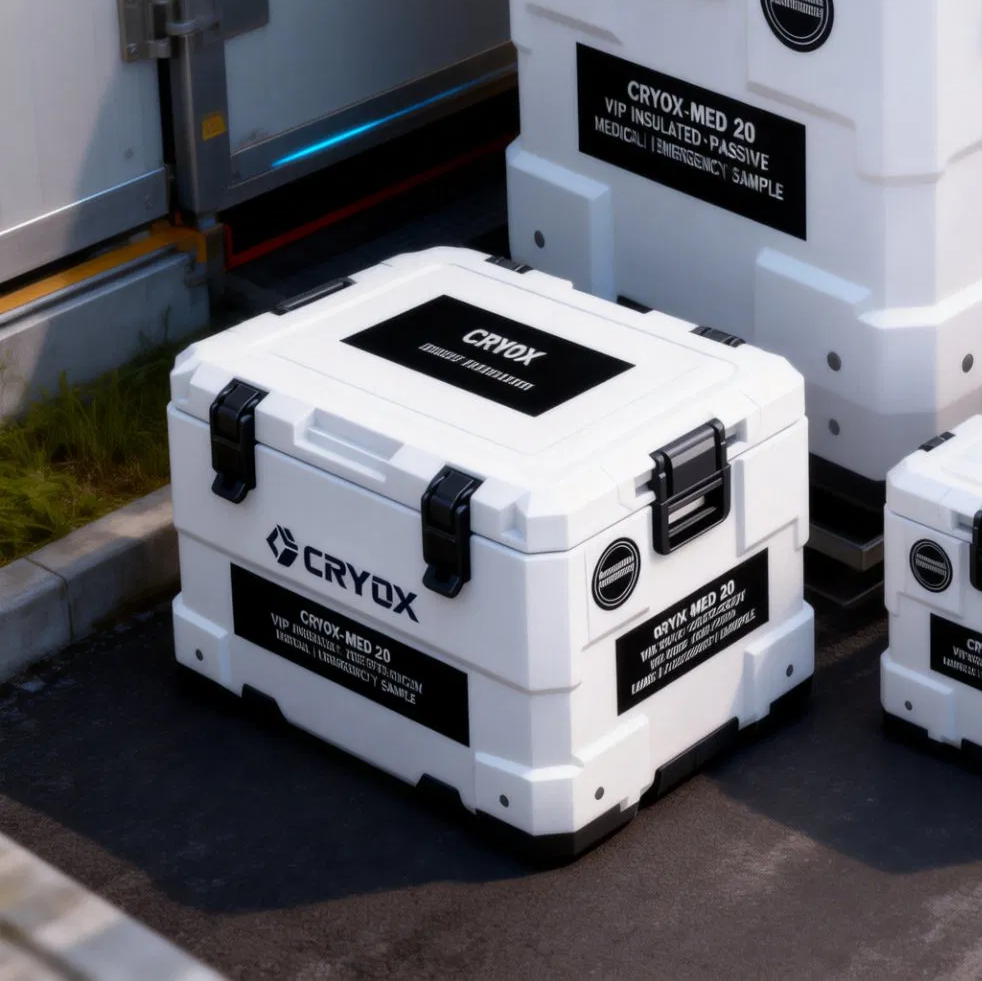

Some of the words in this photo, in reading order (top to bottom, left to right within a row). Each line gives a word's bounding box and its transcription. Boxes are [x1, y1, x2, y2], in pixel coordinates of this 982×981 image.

[605, 97, 627, 119] VIP
[627, 80, 728, 133] CRYOX-MED
[733, 118, 756, 144] 20
[462, 328, 547, 367] CRYOX
[303, 545, 420, 624] CRYOX
[719, 579, 735, 601] 20
[270, 612, 290, 630] VIP
[300, 610, 372, 654] CRYOX-MED
[375, 645, 391, 663] 20
